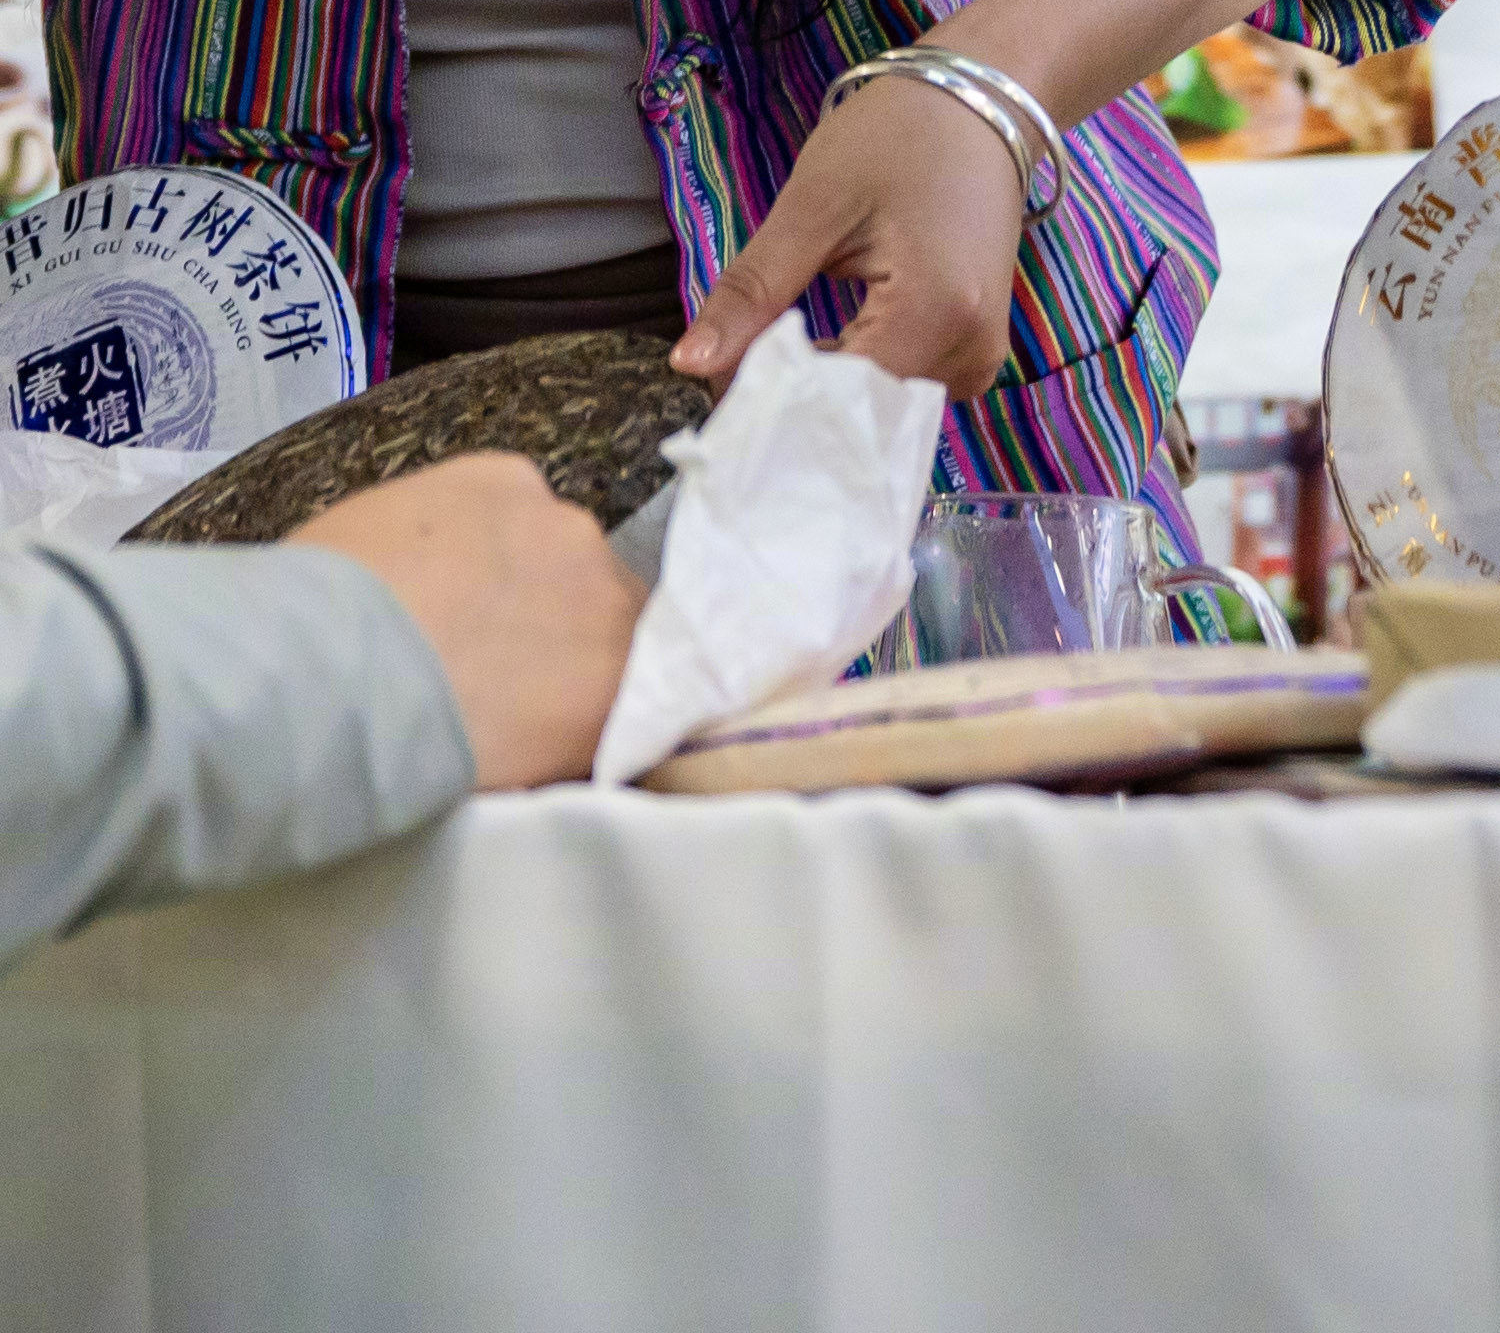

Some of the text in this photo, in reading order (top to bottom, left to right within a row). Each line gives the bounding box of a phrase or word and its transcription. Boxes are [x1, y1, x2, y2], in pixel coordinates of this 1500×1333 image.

[8, 271, 34, 294] XI
[44, 248, 82, 273] GUI
[92, 238, 122, 256] GU
[131, 238, 177, 262] SHU
[182, 258, 219, 295] CHA
[218, 296, 252, 353] BING
[1417, 265, 1446, 321] YUN
[1441, 214, 1482, 265] NAN
[78, 341, 131, 444] 火塘
